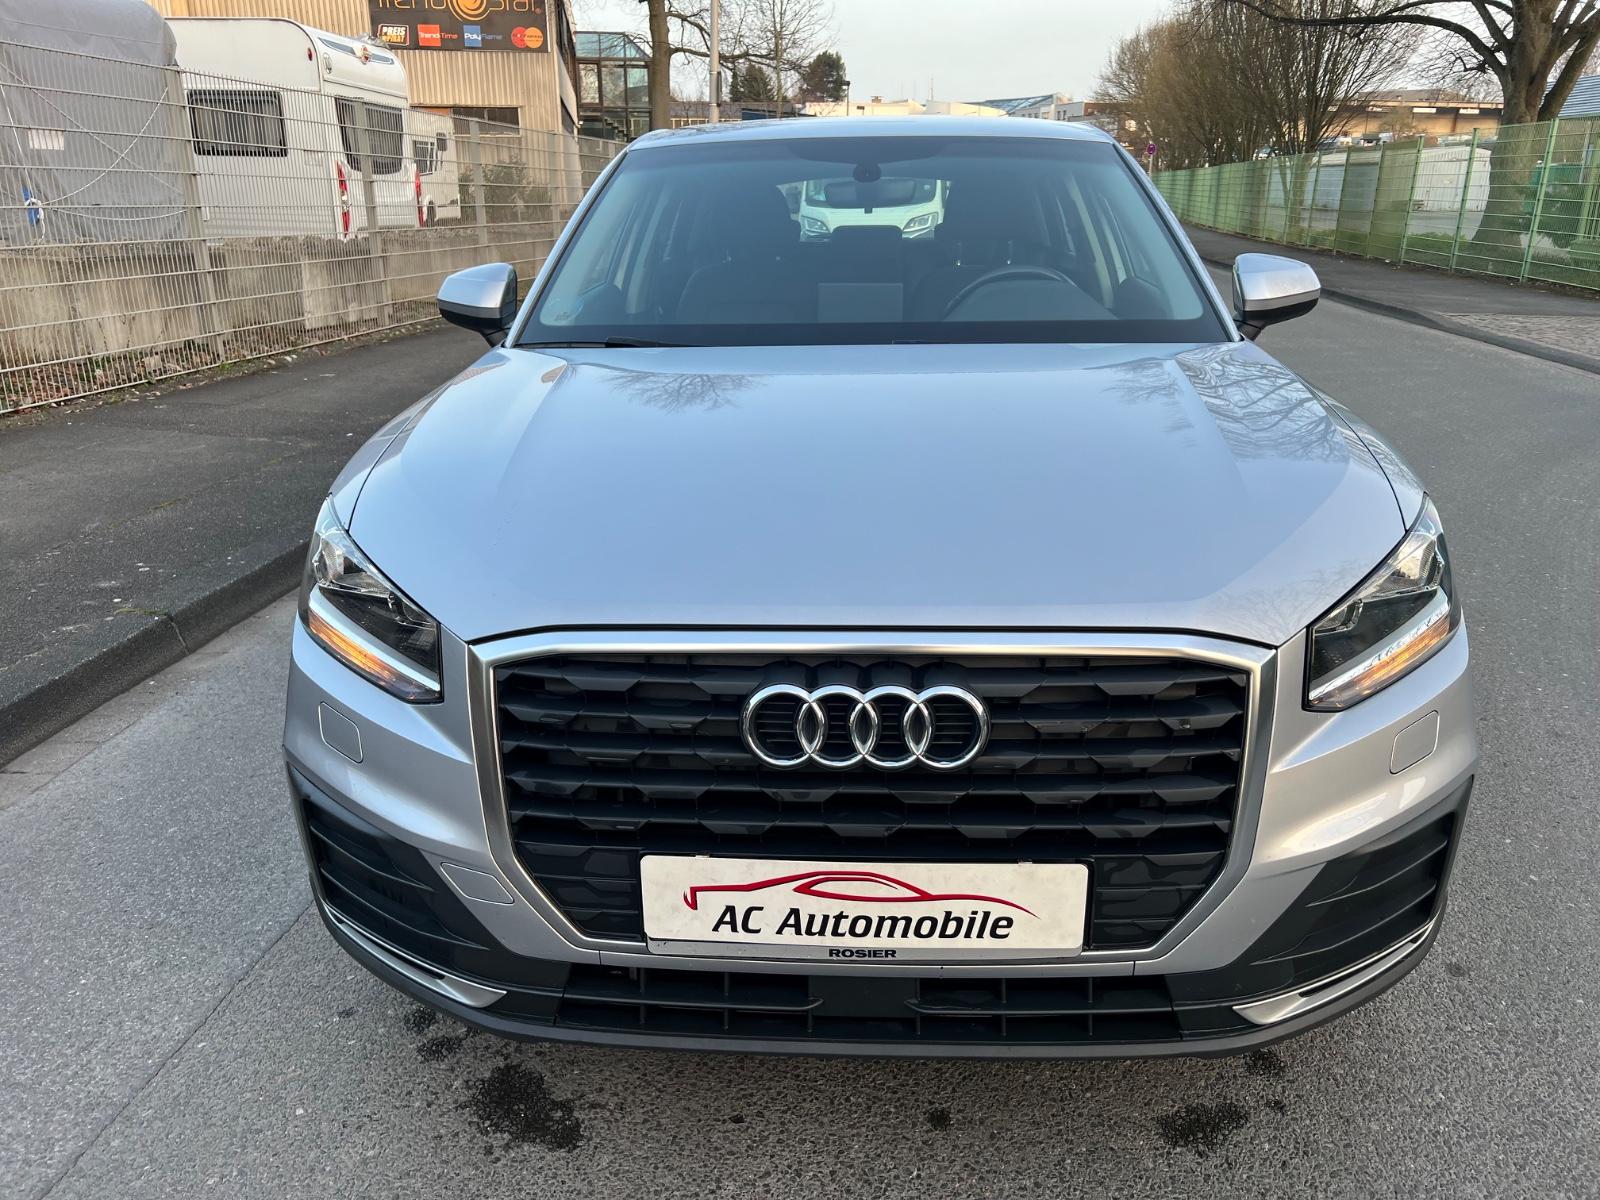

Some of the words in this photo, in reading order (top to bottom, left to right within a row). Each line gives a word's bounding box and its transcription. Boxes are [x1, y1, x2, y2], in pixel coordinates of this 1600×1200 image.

[382, 26, 406, 35] PREIS
[711, 905, 764, 933] AC
[775, 908, 1014, 939] Automobile
[828, 948, 896, 958] ROSIER
